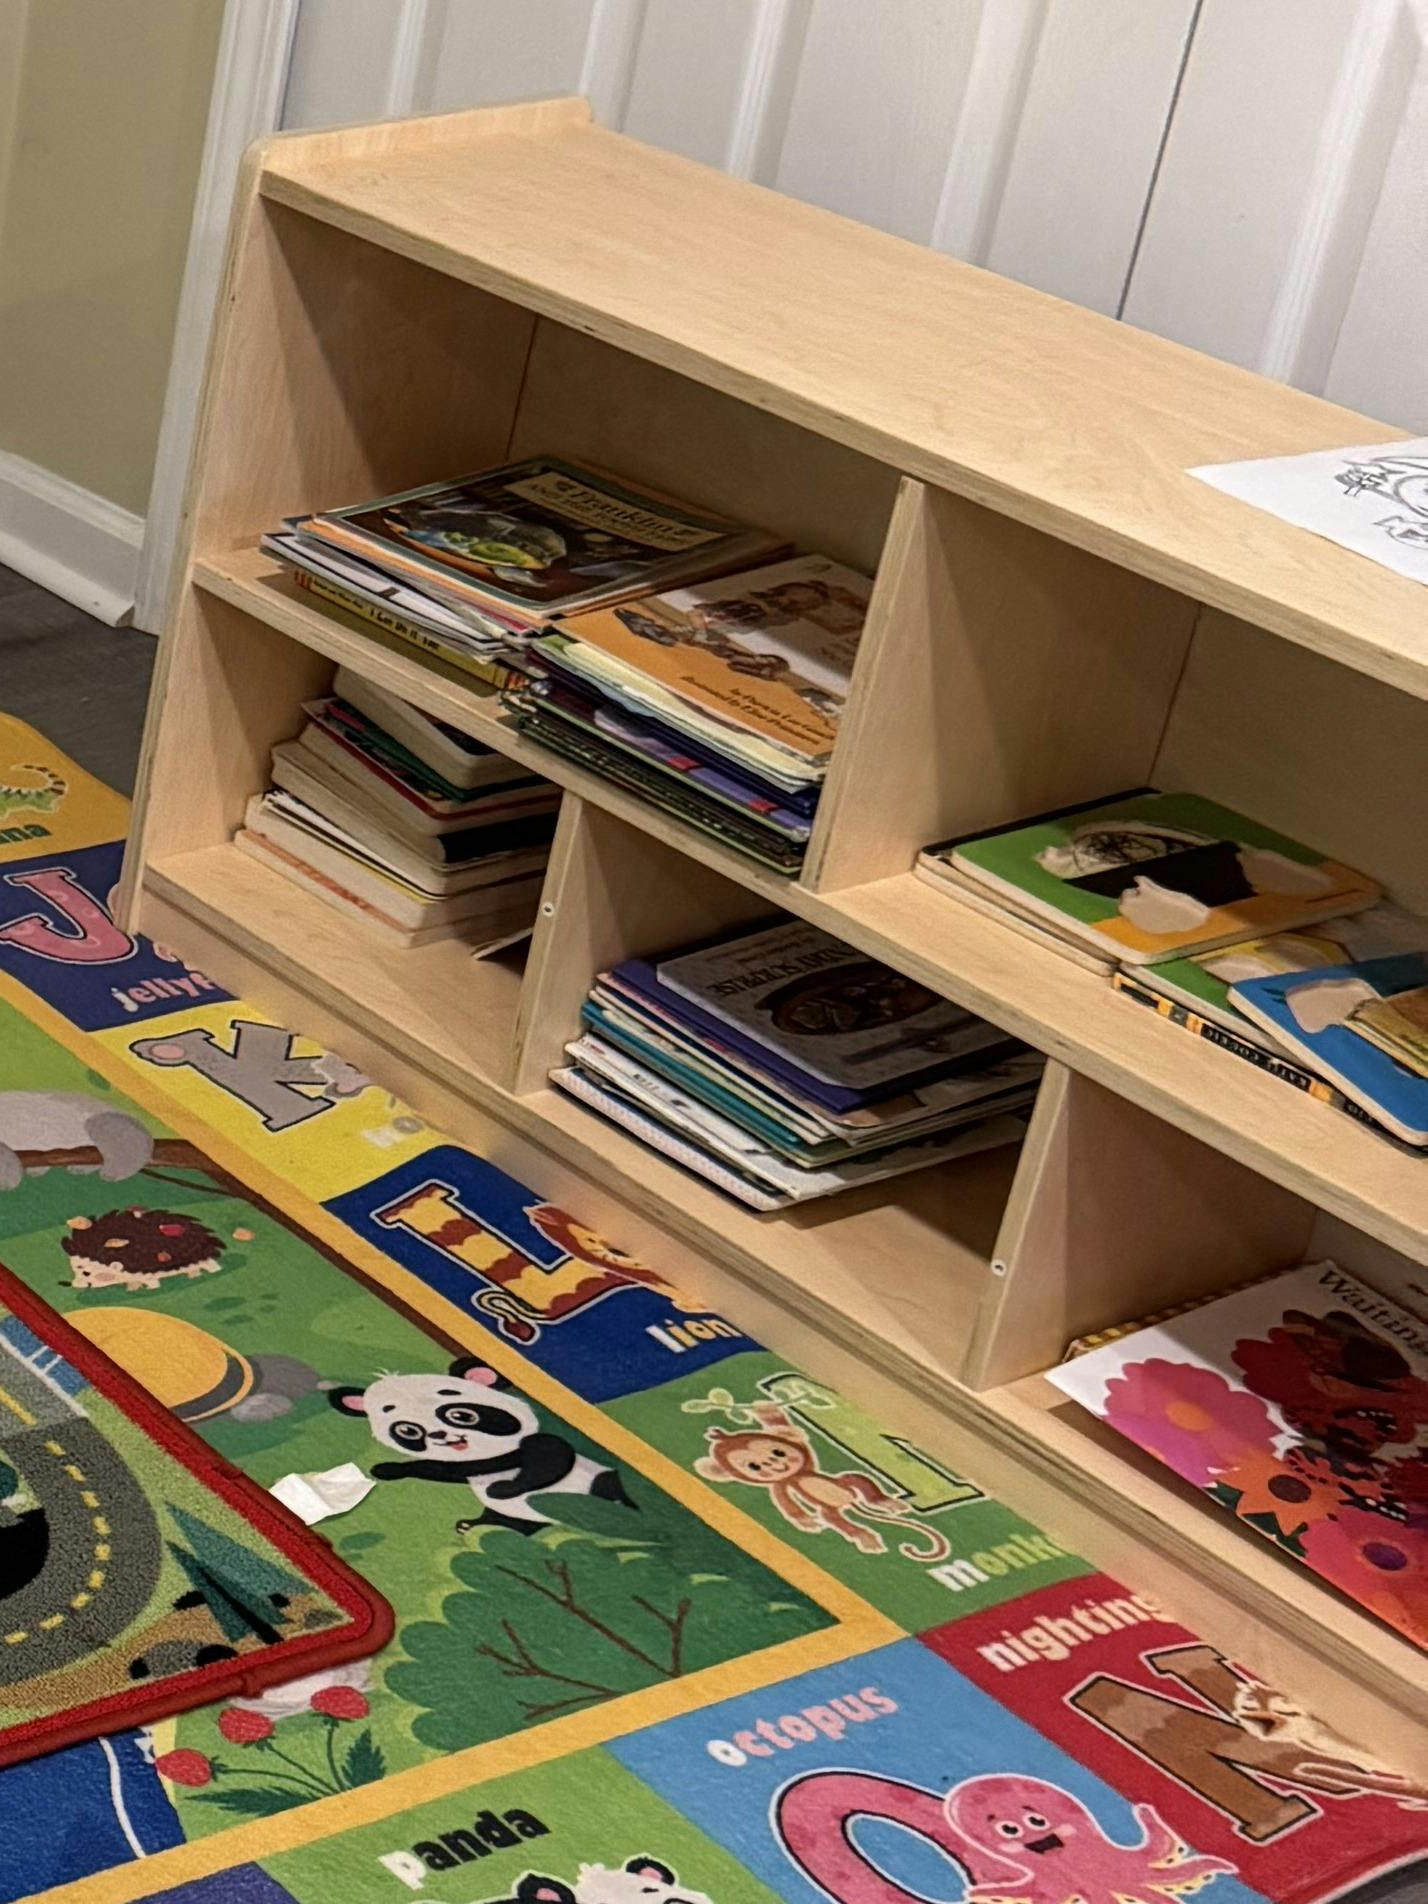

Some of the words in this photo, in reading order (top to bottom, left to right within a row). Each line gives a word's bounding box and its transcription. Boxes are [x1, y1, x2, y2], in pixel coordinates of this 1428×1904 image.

[129, 1020, 335, 1132] K
[372, 1180, 639, 1342] L
[645, 1315, 742, 1354] lion
[706, 1684, 899, 1766] octopus
[1062, 1642, 1361, 1846] N
[379, 1803, 551, 1891] panda
